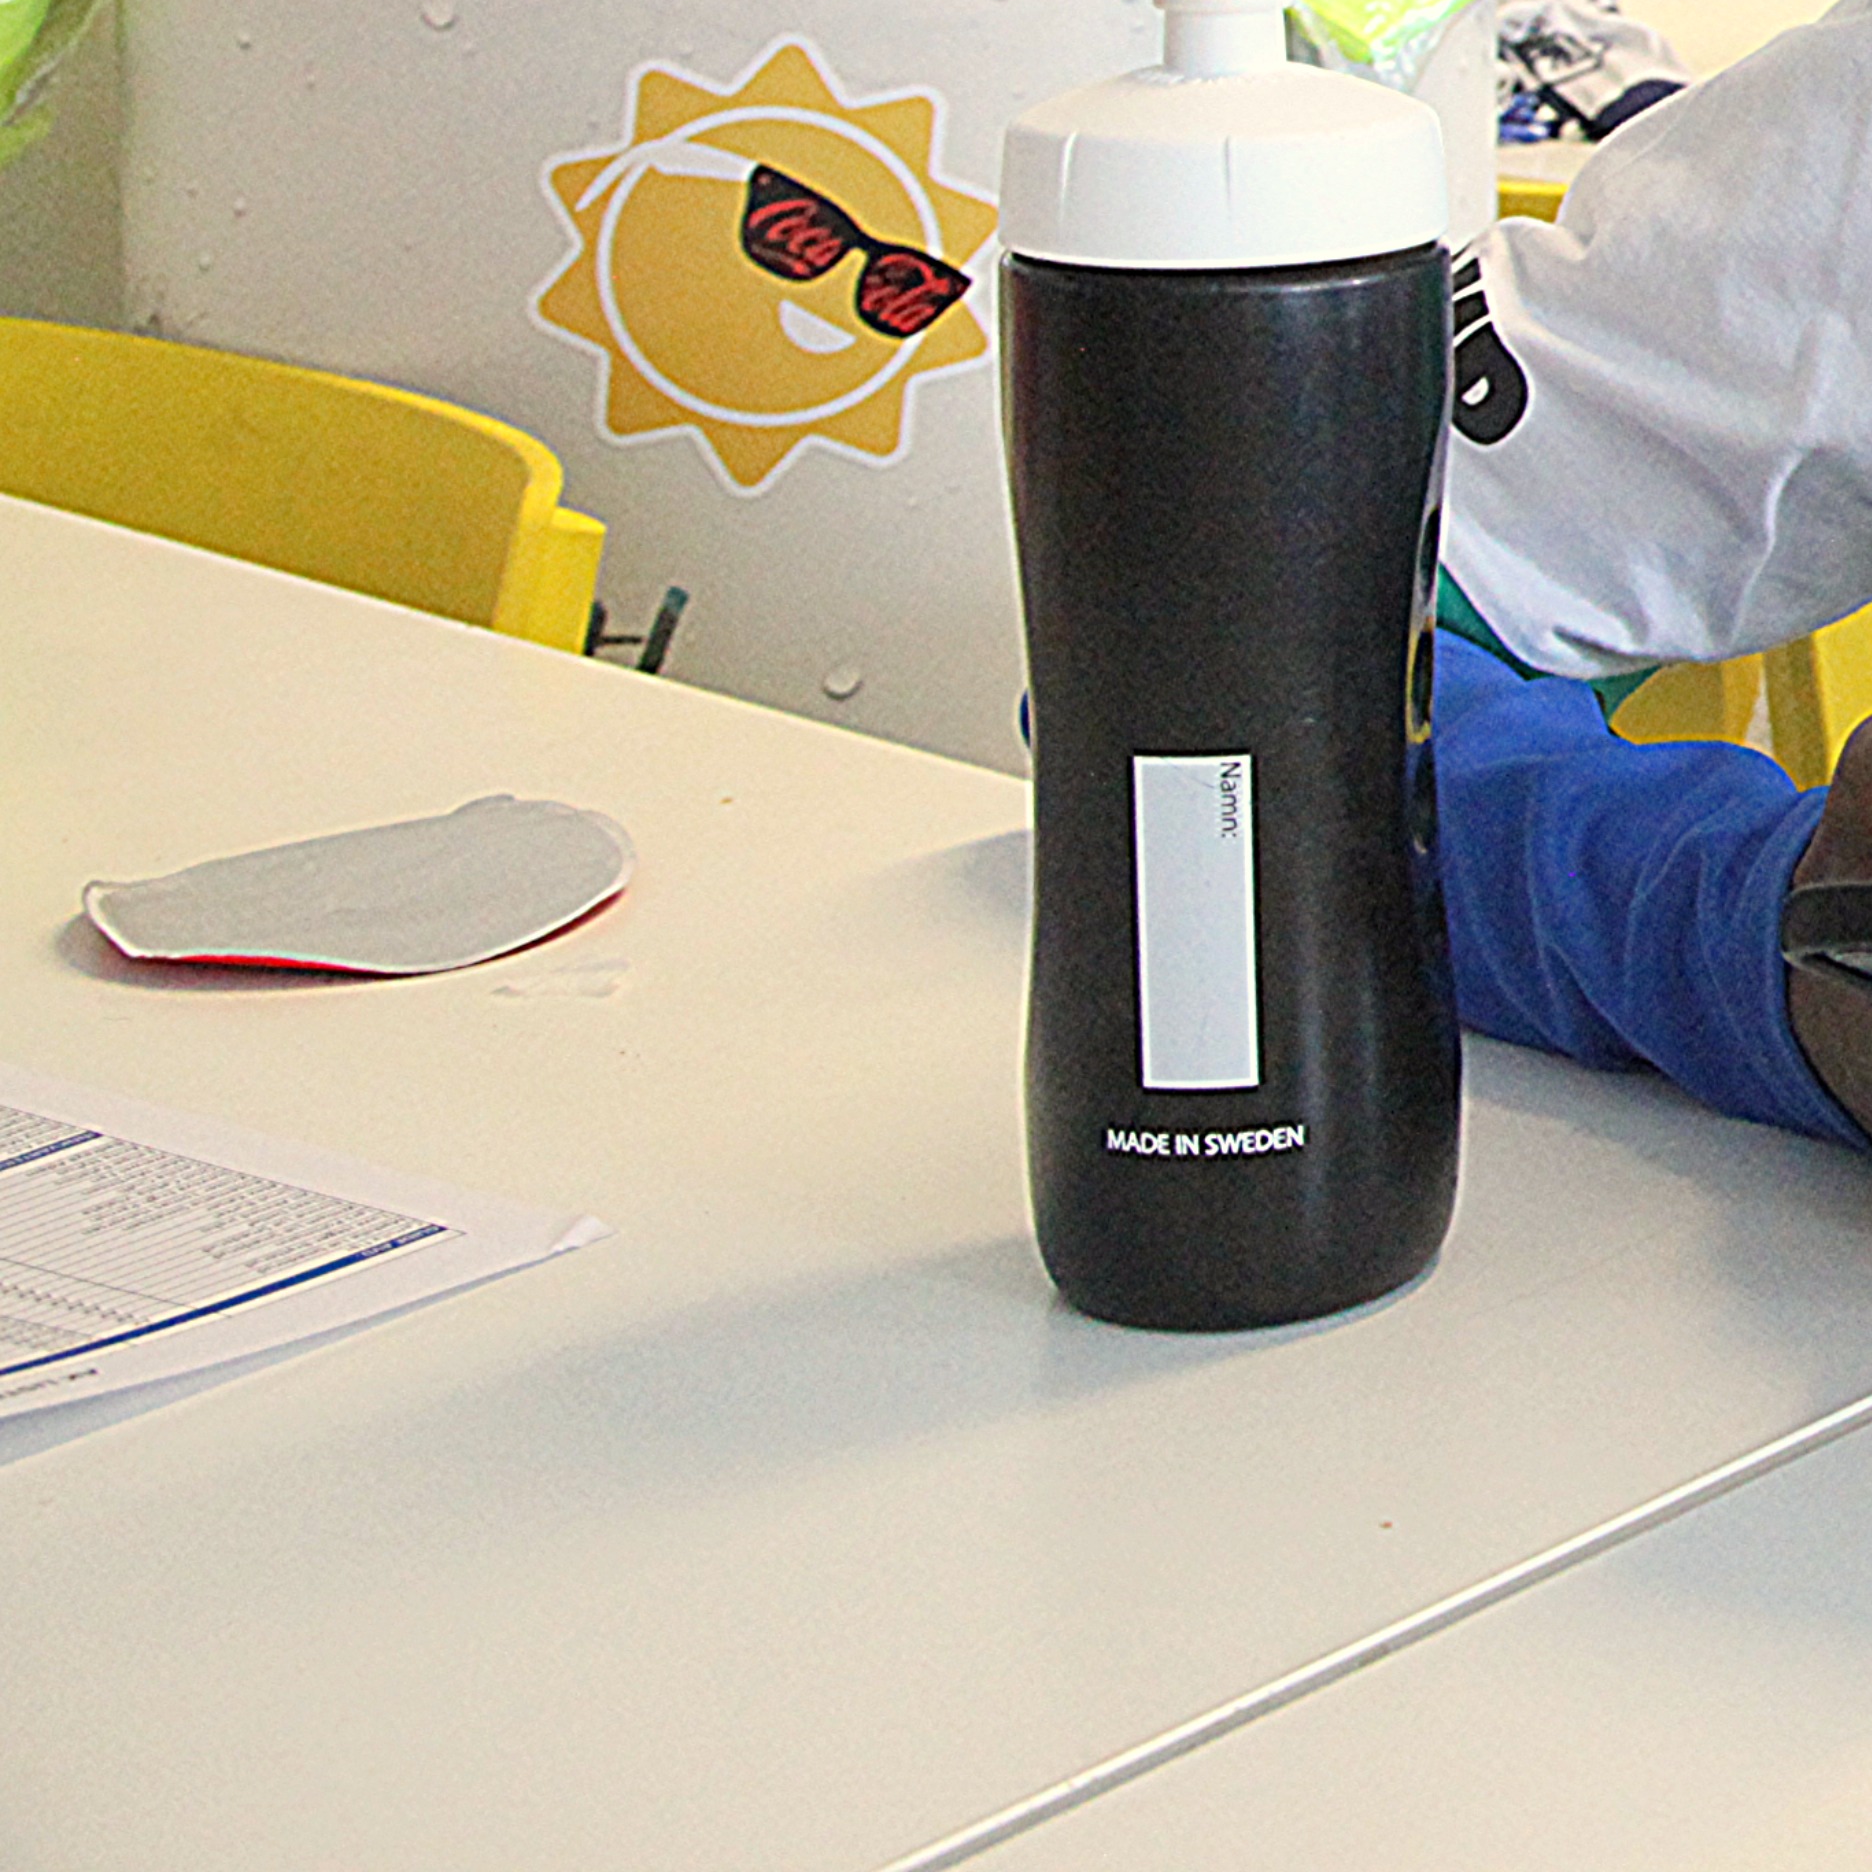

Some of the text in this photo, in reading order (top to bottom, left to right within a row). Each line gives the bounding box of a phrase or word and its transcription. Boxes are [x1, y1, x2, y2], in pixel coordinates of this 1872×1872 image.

[1219, 761, 1242, 839] Namn:
[1106, 1125, 1305, 1157] MADE IN SWEDEN
